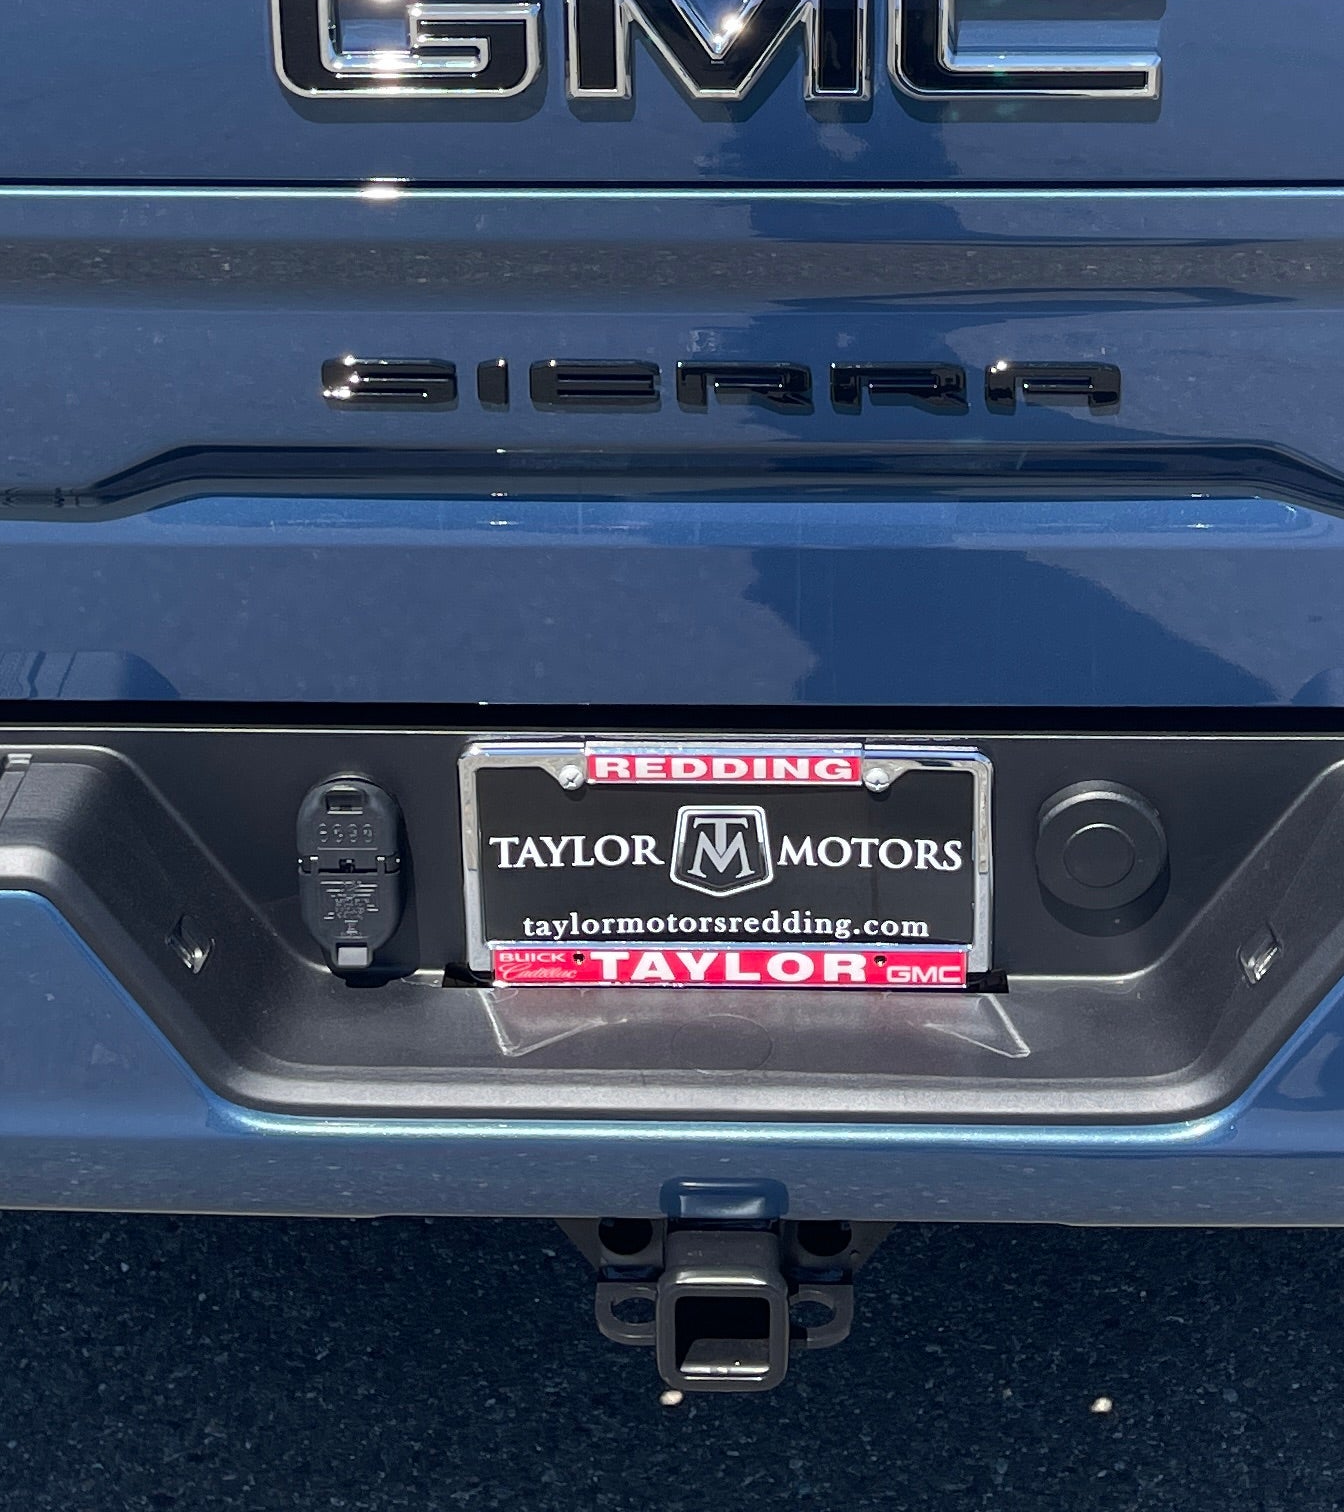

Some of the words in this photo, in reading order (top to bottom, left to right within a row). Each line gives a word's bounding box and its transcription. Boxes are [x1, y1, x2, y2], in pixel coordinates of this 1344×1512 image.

[321, 357, 1122, 414] SIERRA
[594, 757, 853, 780] REDDING
[489, 834, 666, 869] TAYLOR
[776, 835, 962, 871] MOTORS
[523, 910, 929, 940] taylormotorsredding.com
[499, 952, 567, 963] BUICK
[590, 951, 867, 982] TAYLOR
[498, 962, 577, 981] Cadillac
[886, 965, 961, 983] GMC
